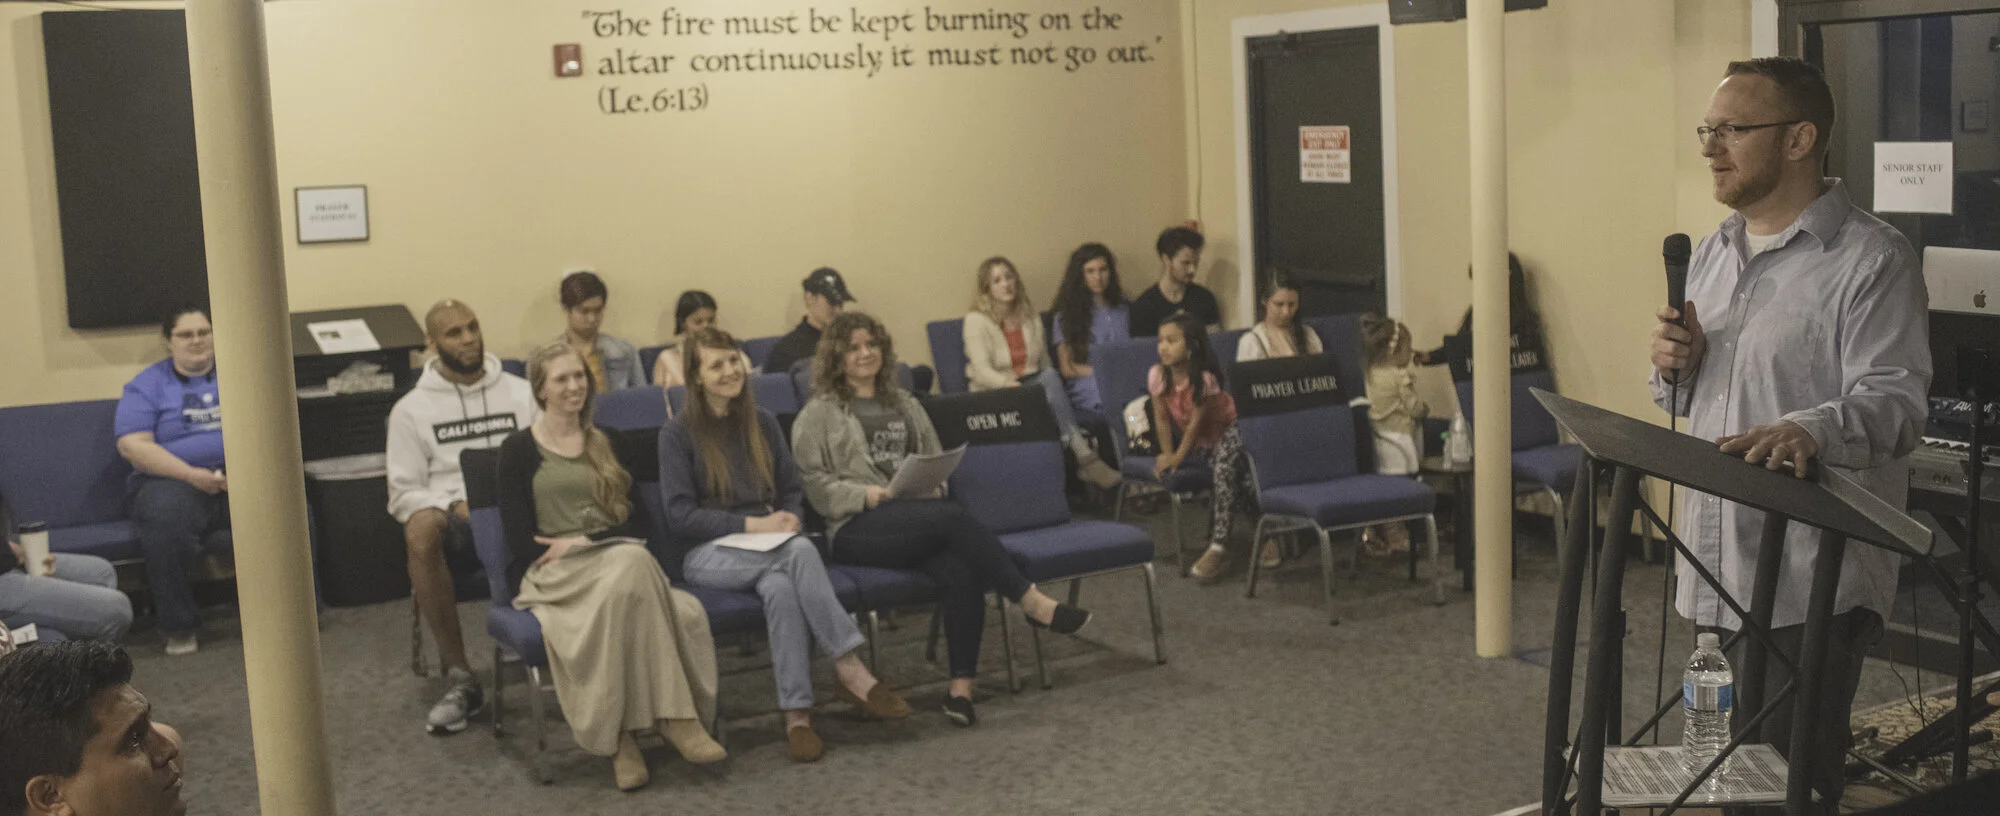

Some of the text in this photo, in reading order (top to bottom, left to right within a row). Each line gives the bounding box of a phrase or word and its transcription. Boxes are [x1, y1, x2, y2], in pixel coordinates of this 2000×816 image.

[661, 6, 715, 36] fire
[724, 13, 800, 35] must
[809, 7, 842, 33] be
[851, 6, 915, 41] kept
[924, 6, 1030, 39] burning
[1039, 12, 1071, 31] on
[1081, 6, 1123, 31] the
[598, 48, 675, 75] altar
[892, 45, 915, 67] it
[927, 46, 1002, 67] must
[1010, 43, 1058, 65] not
[1064, 45, 1098, 72] go
[598, 82, 709, 116] (Le.6:13)
[1882, 163, 1944, 173] SENIOR STAFF
[1900, 176, 1925, 186] ONLY
[1251, 376, 1337, 399] PRAYER LEADER
[437, 416, 515, 440] CALIFORNIA
[966, 411, 1022, 431] OPEN MIC
